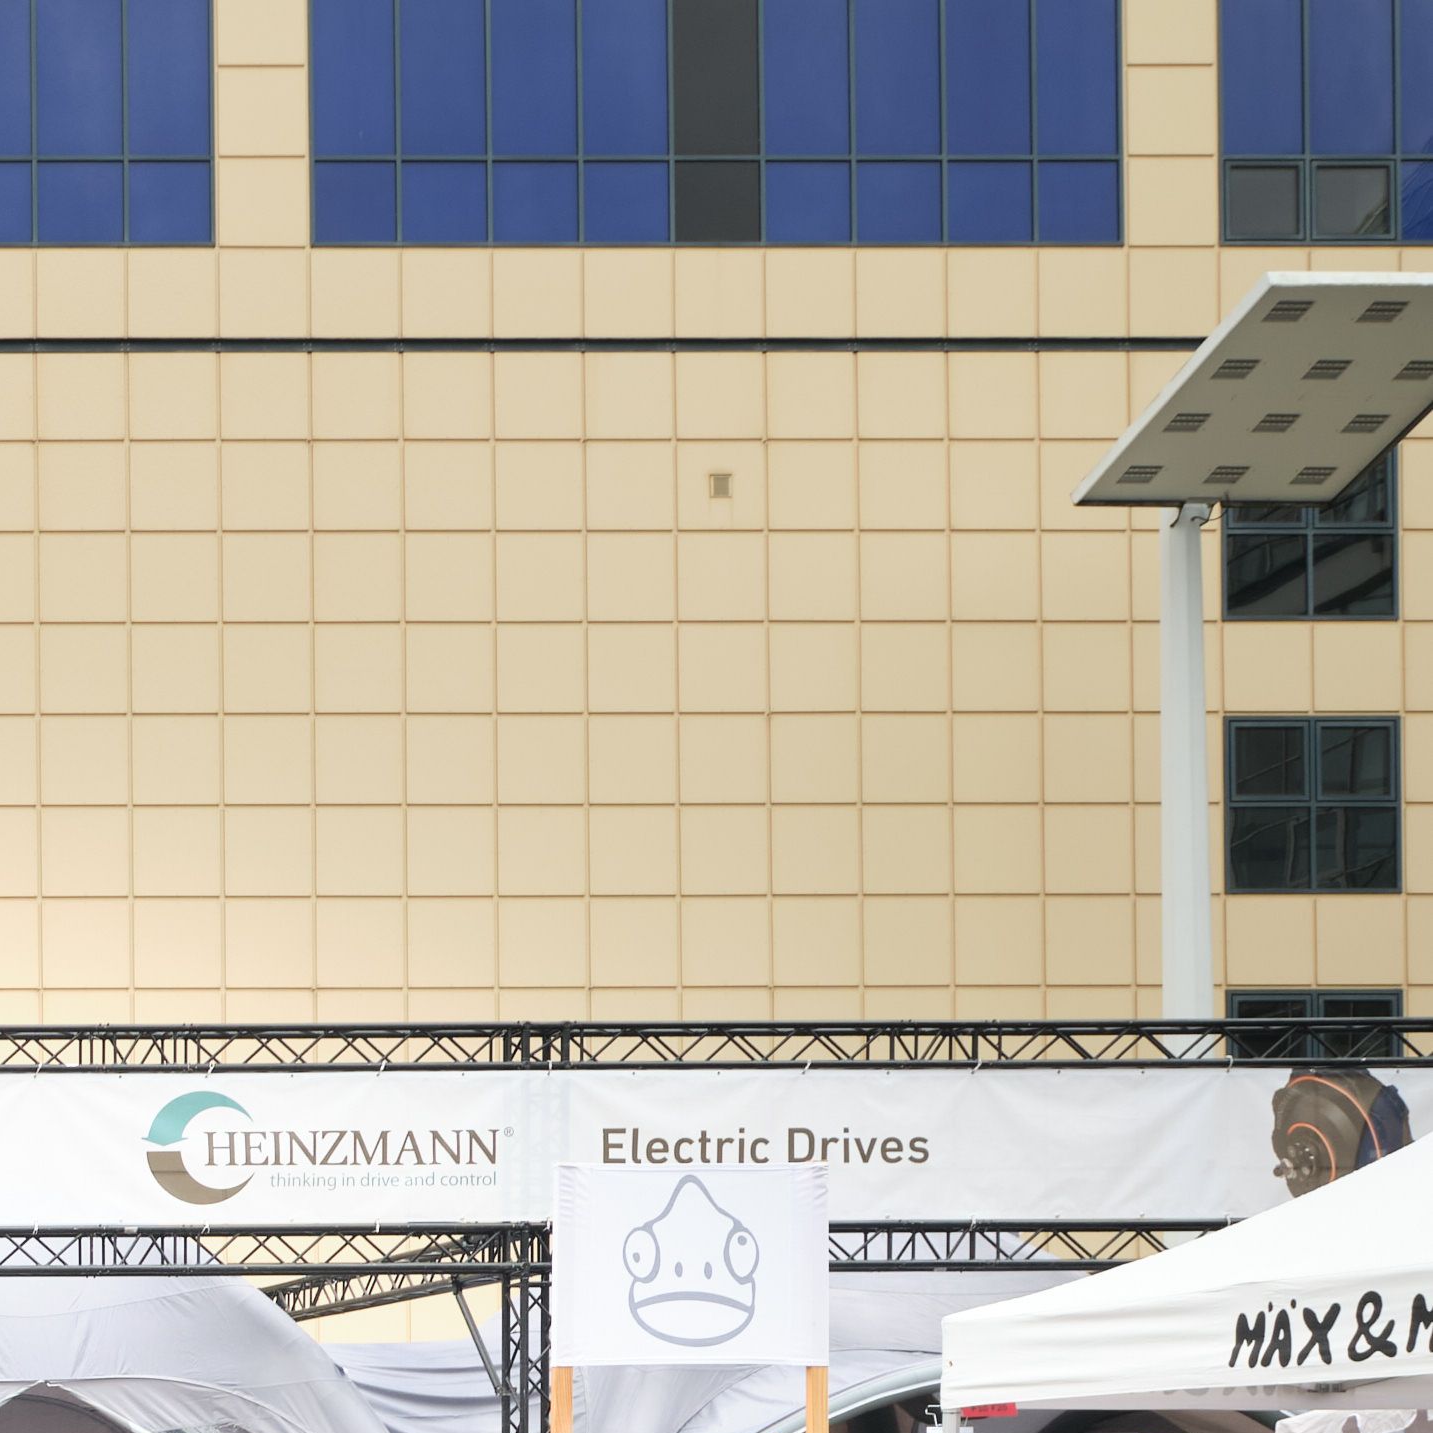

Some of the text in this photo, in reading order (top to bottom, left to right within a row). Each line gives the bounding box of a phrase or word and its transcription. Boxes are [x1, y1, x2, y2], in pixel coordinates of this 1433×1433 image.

[602, 1127, 929, 1164] Electric Drives
[271, 1171, 497, 1190] thinking in drive and control
[1229, 1299, 1341, 1368] MÄX
[1348, 1291, 1397, 1362] &
